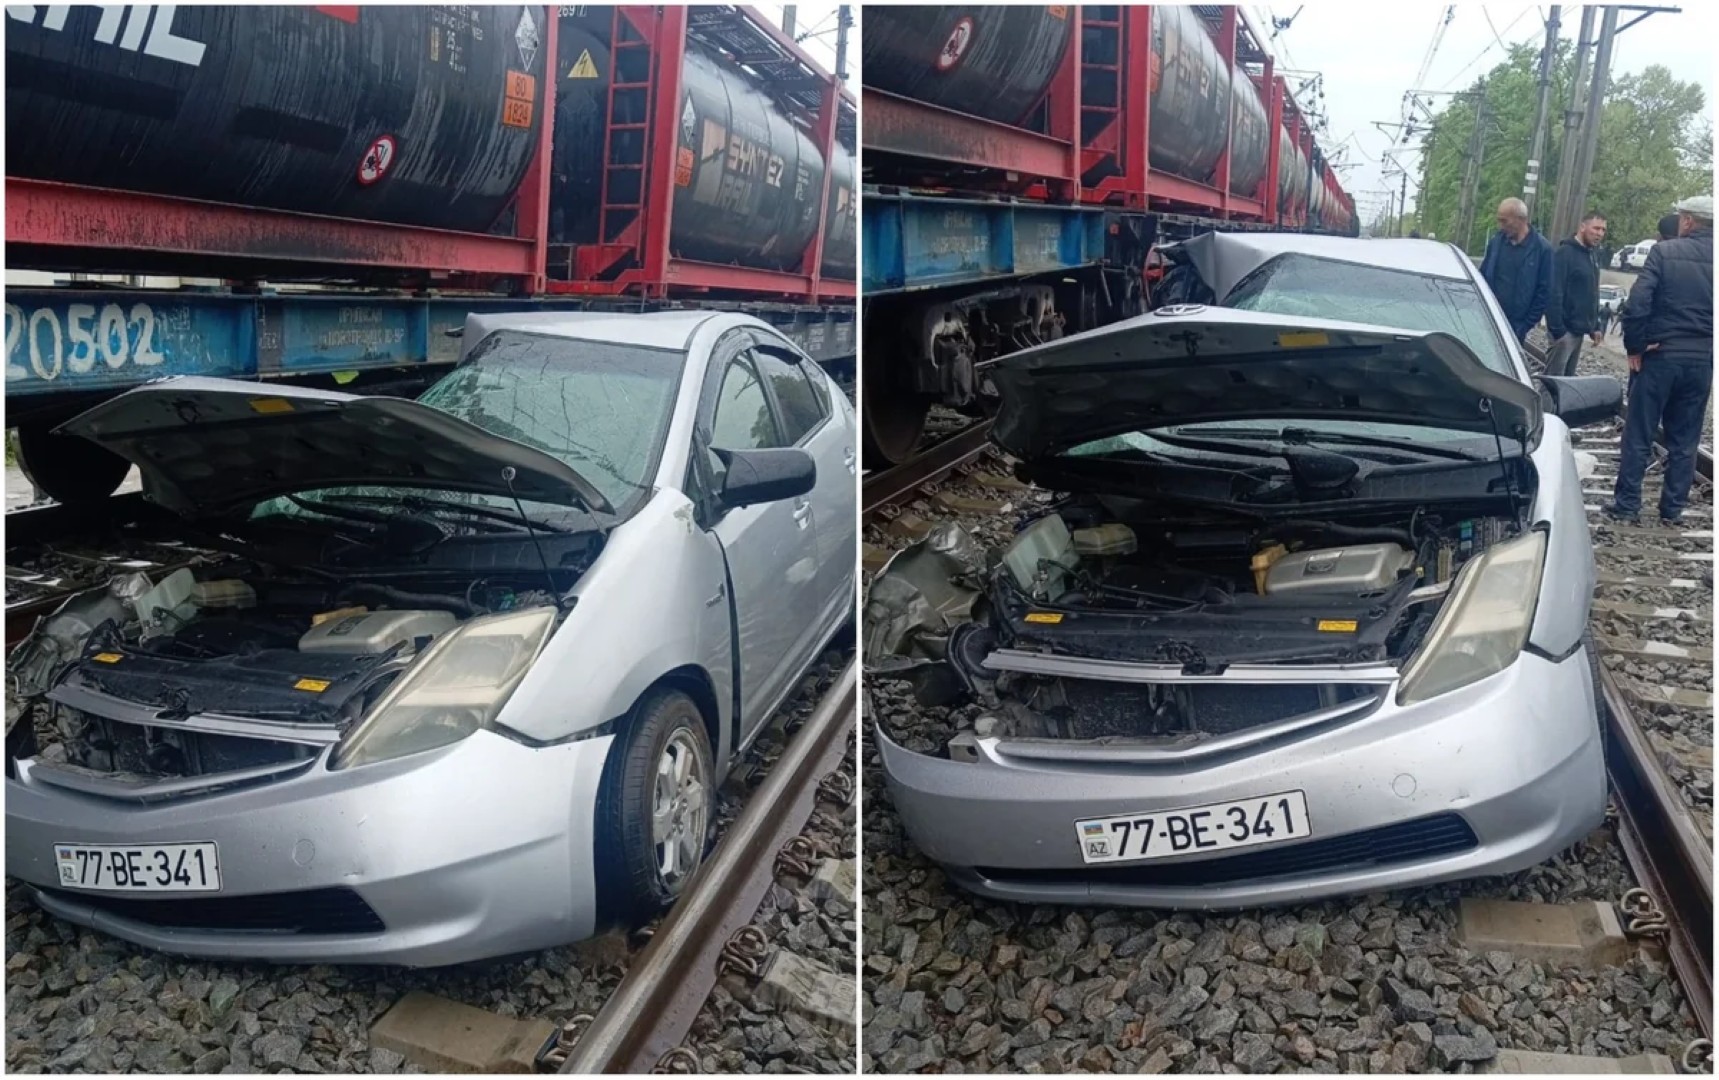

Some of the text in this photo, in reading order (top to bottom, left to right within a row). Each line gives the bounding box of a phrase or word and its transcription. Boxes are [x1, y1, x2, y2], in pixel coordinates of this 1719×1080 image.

[5, 302, 164, 380] 20502
[1089, 841, 1108, 856] AZ
[1111, 798, 1294, 857] 77-BE-341
[76, 848, 207, 887] 77-BE-341
